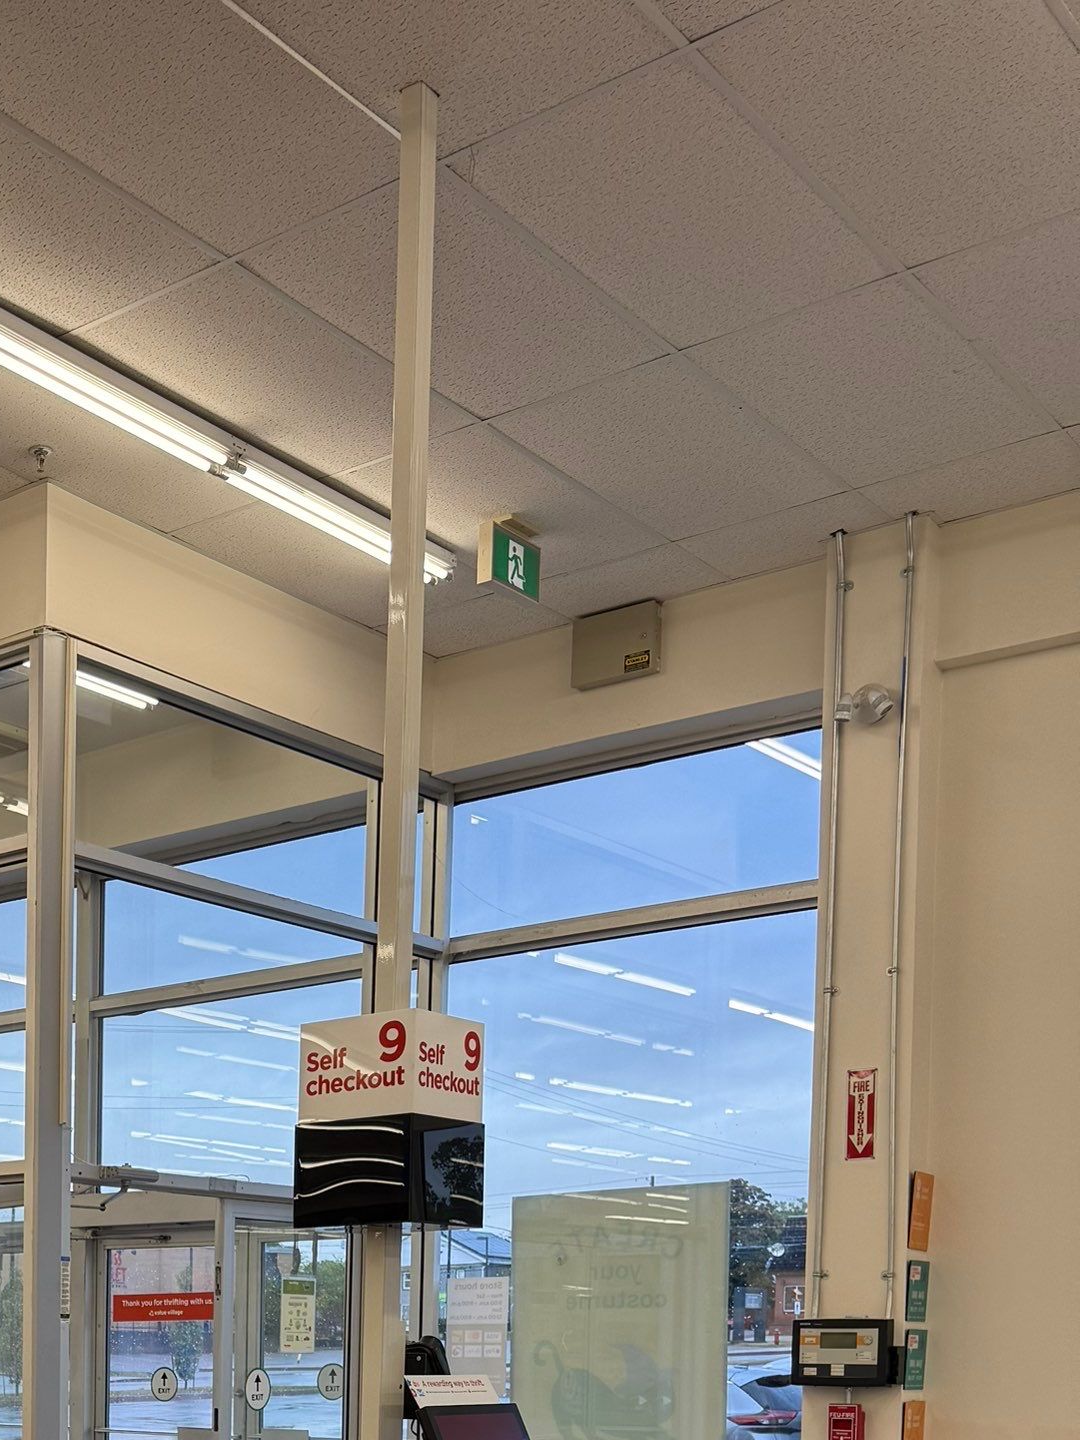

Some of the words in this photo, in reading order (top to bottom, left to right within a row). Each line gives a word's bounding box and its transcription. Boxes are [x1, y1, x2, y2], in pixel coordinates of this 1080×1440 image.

[378, 1020, 406, 1062] 9
[419, 1041, 445, 1065] Self
[464, 1031, 481, 1072] 9
[306, 1047, 347, 1072] Self
[306, 1066, 405, 1096] checkout
[418, 1067, 480, 1096] checkout
[853, 1080, 870, 1093] FIRE
[141, 1300, 153, 1308] you
[164, 1298, 188, 1307] thrifting
[251, 1393, 264, 1401] EXIT
[325, 1385, 340, 1393] EXIT
